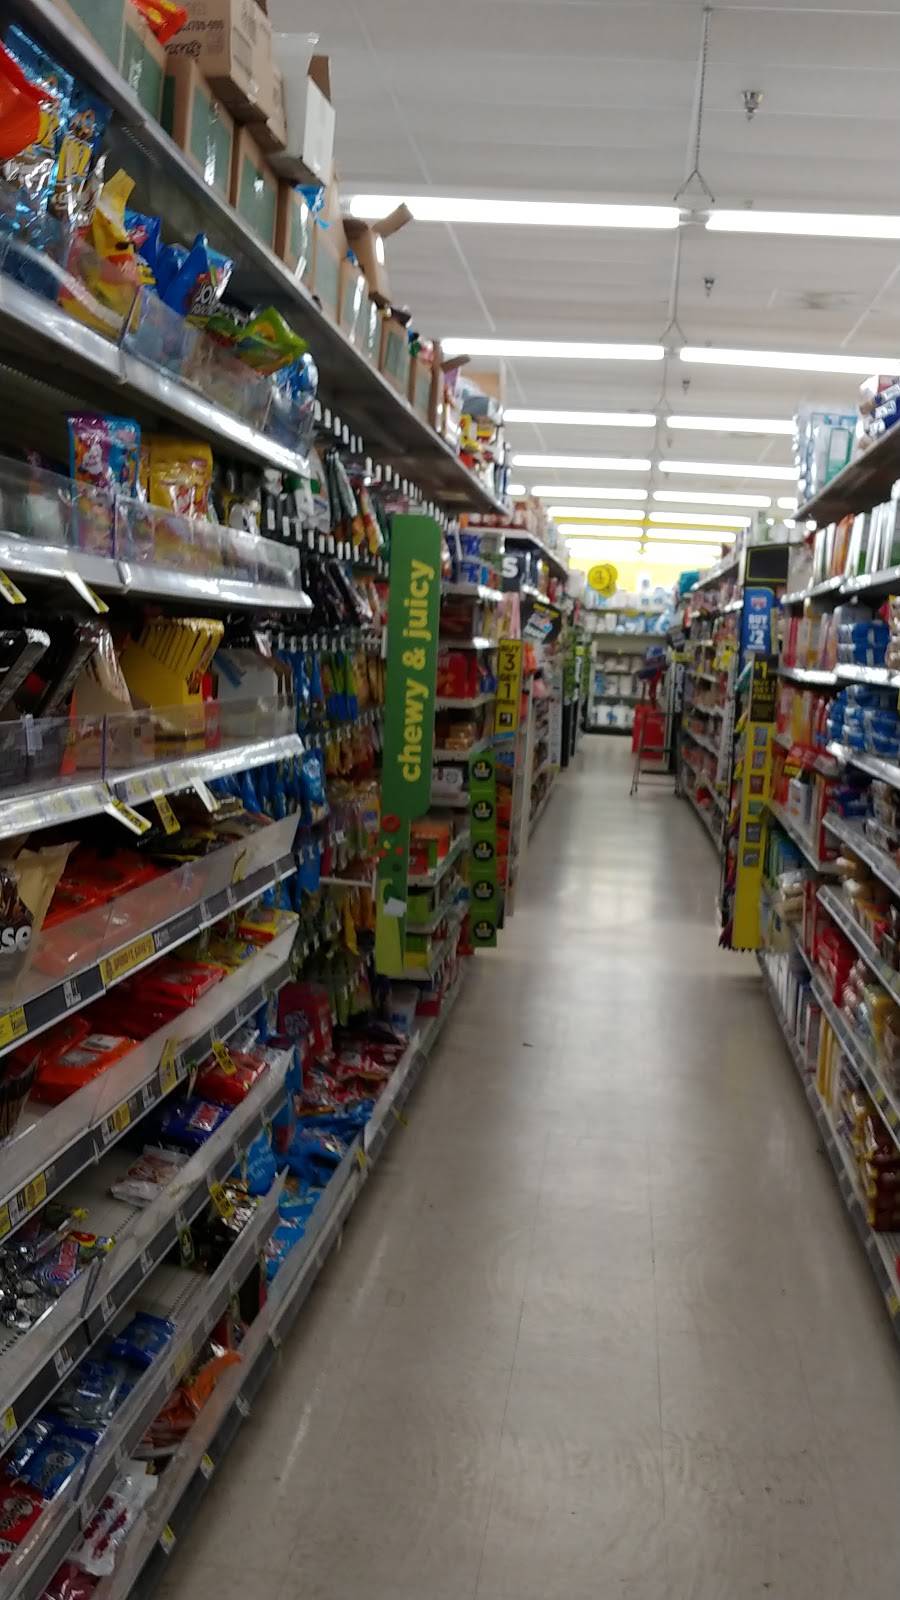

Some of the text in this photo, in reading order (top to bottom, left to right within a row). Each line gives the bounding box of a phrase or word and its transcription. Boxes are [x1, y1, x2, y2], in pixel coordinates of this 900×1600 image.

[397, 559, 437, 782] chewy & juicy
[503, 653, 515, 671] 3
[504, 682, 511, 699] 1
[0, 925, 33, 954] se
